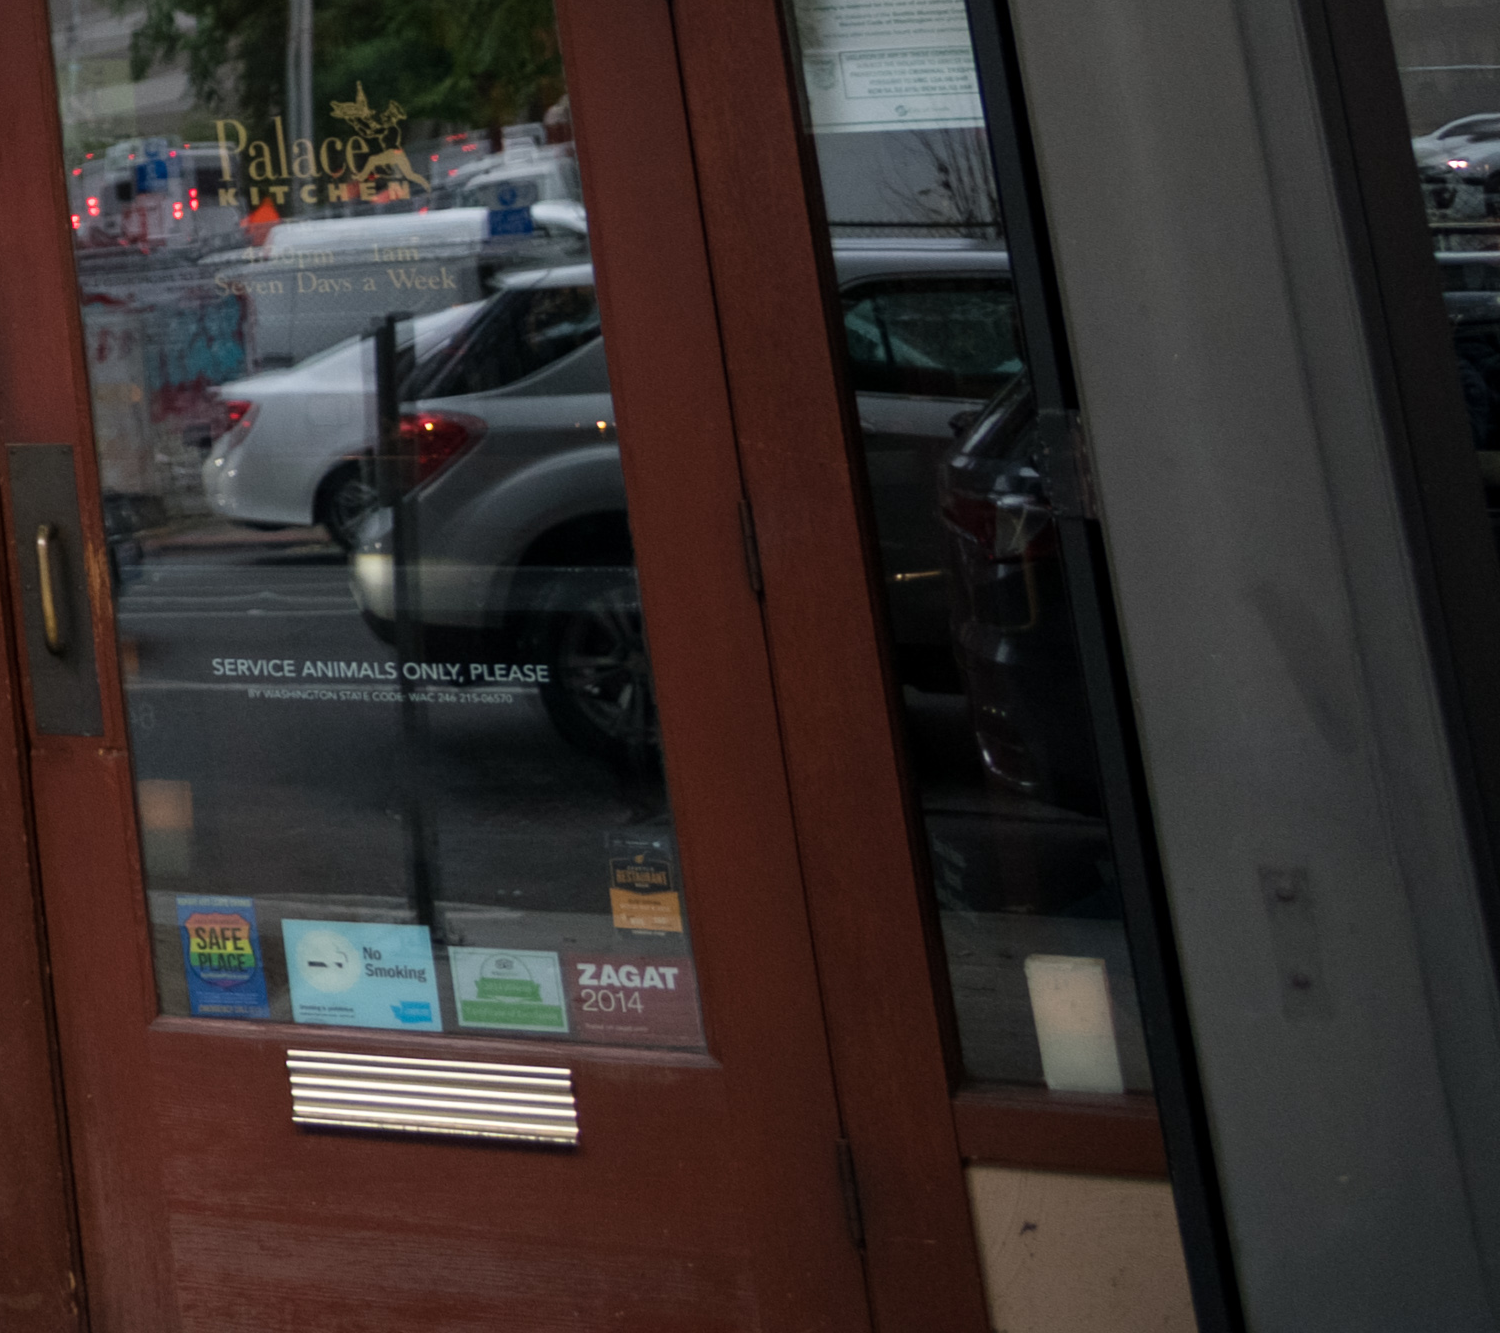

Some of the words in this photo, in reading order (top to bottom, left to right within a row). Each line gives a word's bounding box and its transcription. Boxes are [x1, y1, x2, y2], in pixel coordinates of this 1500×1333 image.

[213, 116, 370, 182] Palace
[218, 181, 411, 206] KITCHEN
[214, 272, 284, 296] Seven
[297, 271, 351, 295] Days
[363, 277, 377, 291] a
[387, 267, 458, 291] Week
[212, 658, 296, 677] SERVICE
[301, 660, 397, 679] ANIMALS
[402, 662, 464, 683] ONLY,
[470, 664, 550, 682] PLEASE
[194, 926, 245, 951] SAFE
[197, 953, 249, 972] PLACE
[362, 946, 382, 961] No
[364, 963, 427, 983] Smoking
[576, 963, 679, 990] ZAGAT
[580, 989, 644, 1013] 2014
